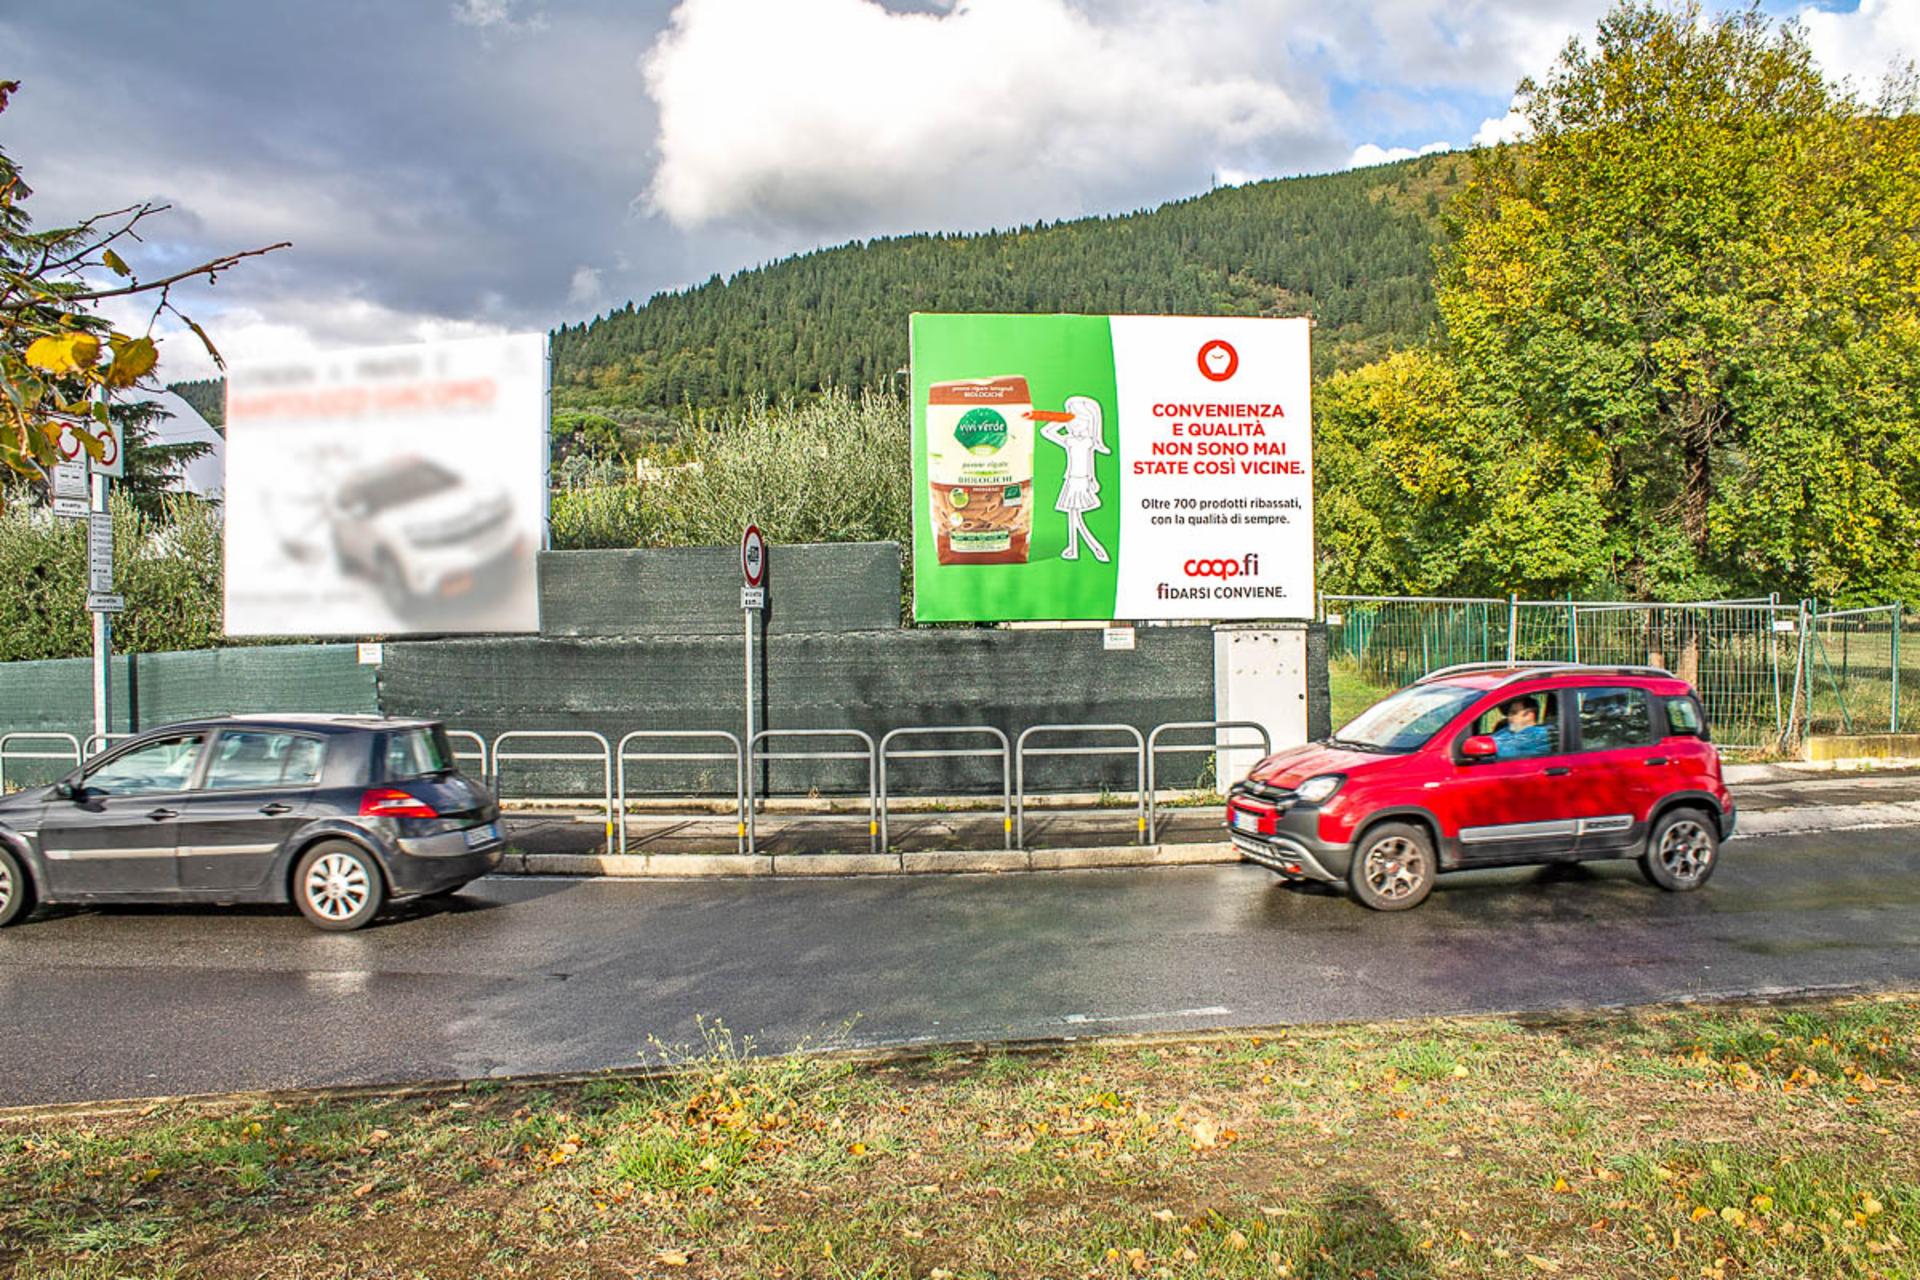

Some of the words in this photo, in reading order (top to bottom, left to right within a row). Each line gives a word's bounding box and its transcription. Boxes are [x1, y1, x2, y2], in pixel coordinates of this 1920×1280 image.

[1152, 403, 1285, 418] CONVENIENZA
[1172, 423, 1184, 437] E
[1188, 420, 1266, 437] QUALITÀ
[1152, 442, 1193, 456] NON
[1197, 442, 1249, 456] SONO
[1254, 442, 1286, 456] MAI
[1133, 461, 1189, 475] STATE
[1193, 457, 1236, 475] COSÌ
[1241, 461, 1305, 475] VICINE.
[1141, 498, 1171, 510] Oltre
[1174, 498, 1197, 510] 700
[1199, 497, 1248, 511] prodotti
[1250, 497, 1302, 511] ribassati,
[1151, 515, 1172, 525] con
[1175, 513, 1185, 525] la
[1188, 513, 1228, 526] qualità
[1230, 513, 1242, 525] di
[1244, 515, 1290, 526] sempre.
[1183, 553, 1259, 581] coop.fi
[1214, 586, 1287, 599] CONVIENE.
